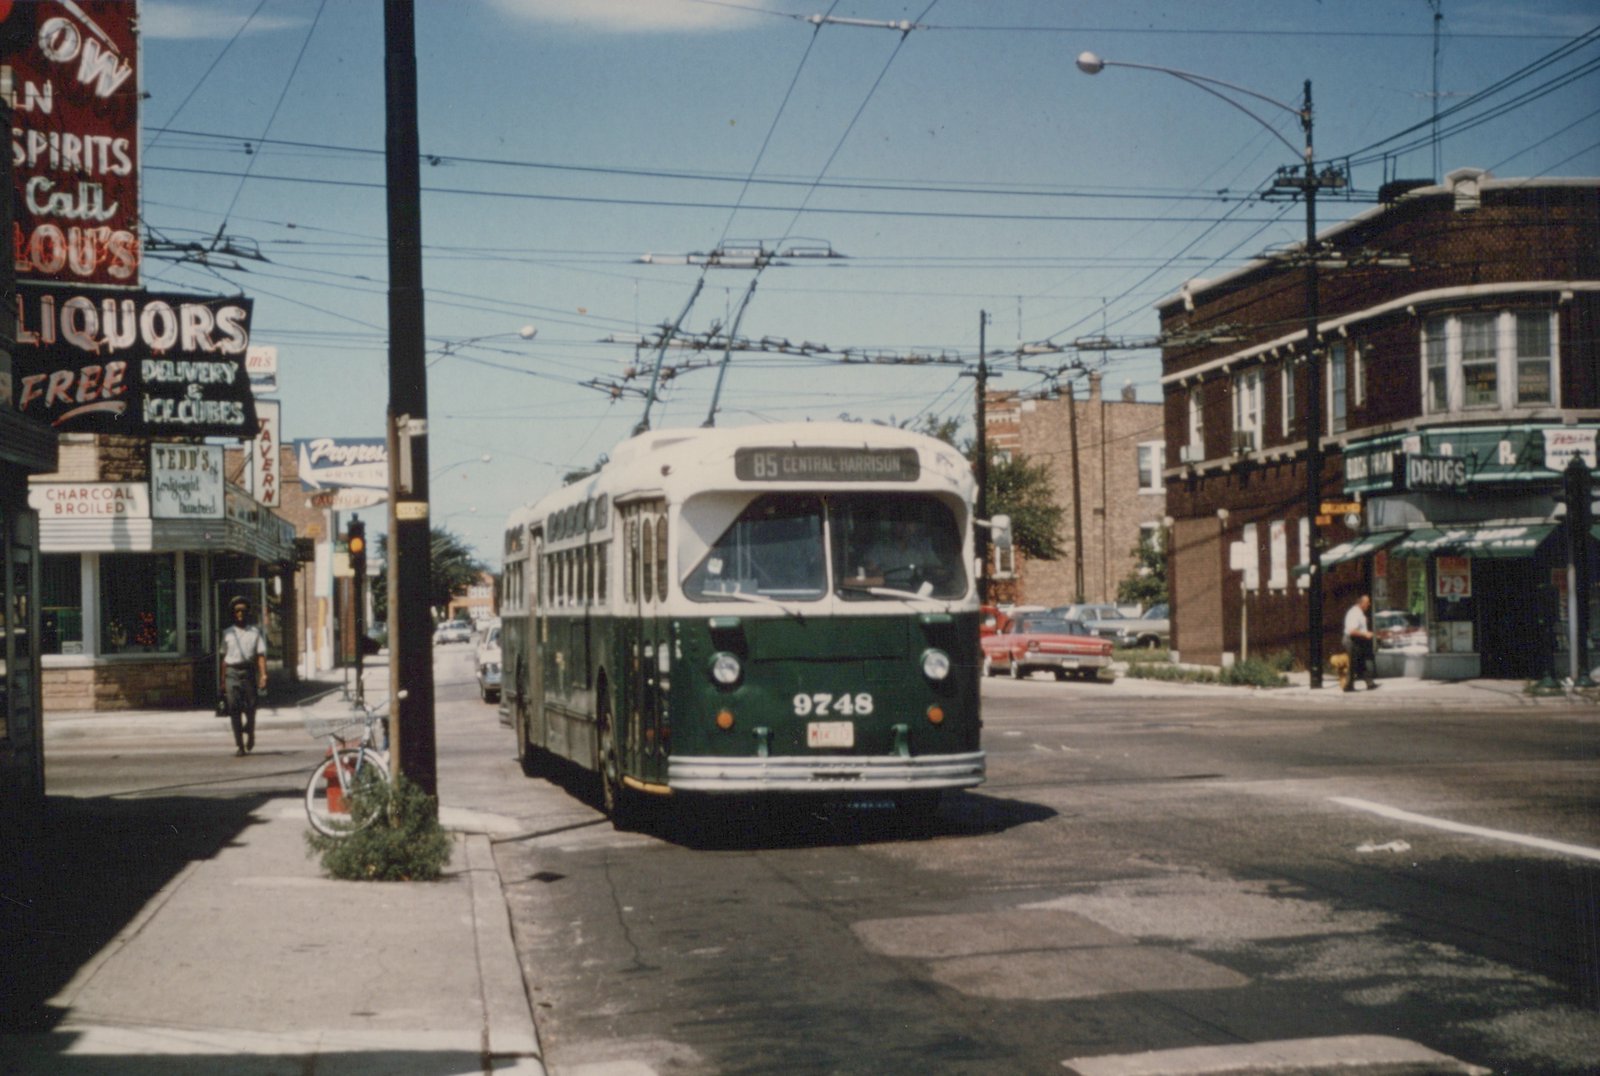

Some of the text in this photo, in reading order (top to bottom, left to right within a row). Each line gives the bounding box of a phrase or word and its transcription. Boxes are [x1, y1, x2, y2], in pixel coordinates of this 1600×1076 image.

[12, 127, 132, 176] SPIRITS
[26, 176, 118, 221] Call
[14, 221, 137, 279] LOU'S
[16, 293, 249, 355] LIQUORS
[19, 361, 128, 411] FREE
[141, 359, 239, 385] DELIVERY
[143, 394, 245, 424] ICE CUBES
[257, 418, 275, 503] TAVERN
[754, 453, 778, 478] 85
[1410, 459, 1465, 485] DRUGS
[46, 488, 134, 501] CHARCOAL
[54, 502, 125, 514] BROILED
[793, 692, 874, 716] 9748
